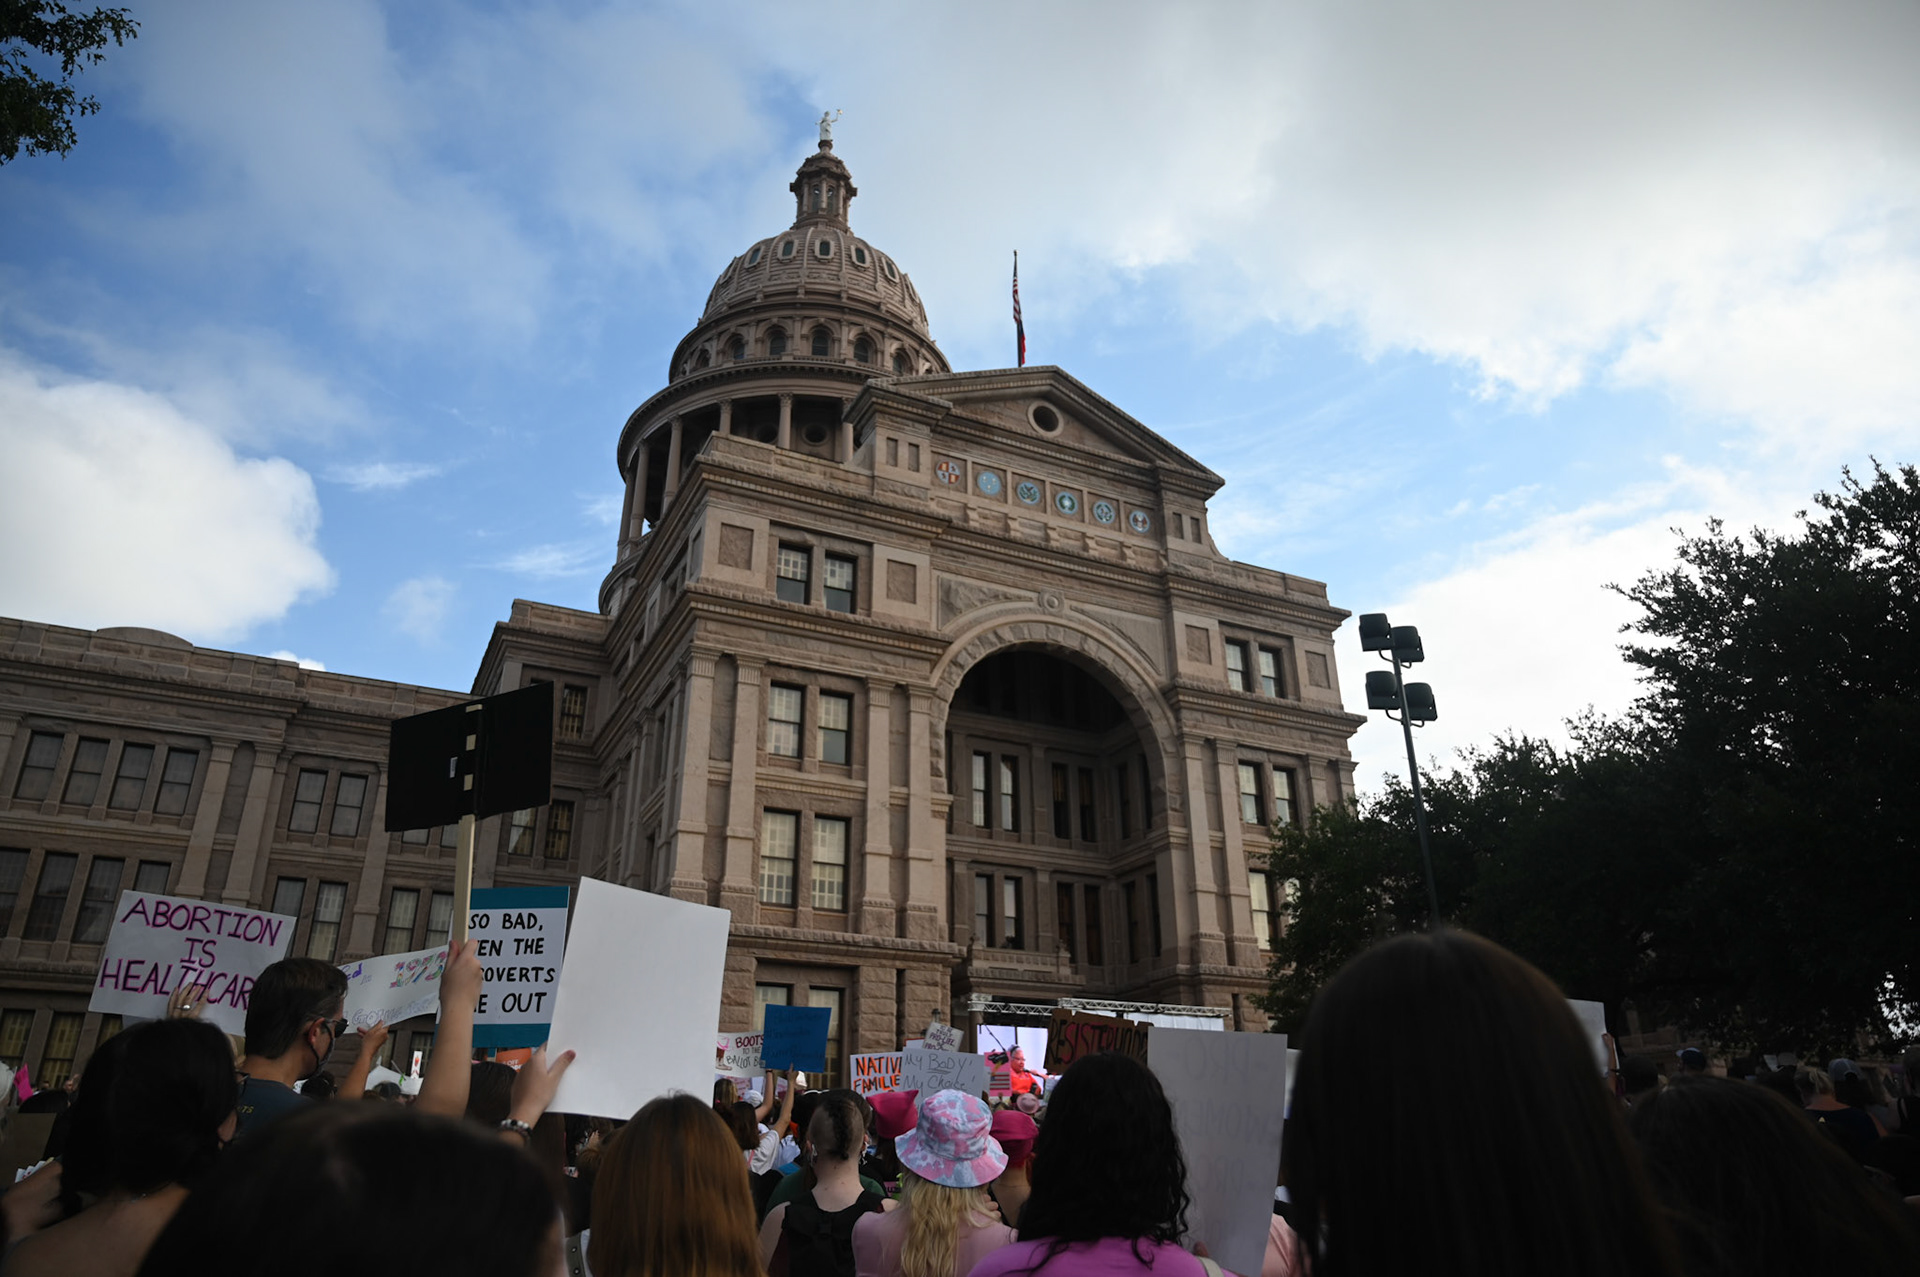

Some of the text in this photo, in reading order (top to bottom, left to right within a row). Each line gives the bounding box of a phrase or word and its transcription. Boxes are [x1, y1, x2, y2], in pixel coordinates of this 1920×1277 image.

[120, 898, 283, 947] ABORTION
[468, 912, 543, 931] SO BAD,
[180, 937, 217, 968] IS
[477, 937, 545, 956] EN THE
[99, 958, 255, 1010] HEALTHCAR
[501, 992, 547, 1013] OUT
[726, 1055, 751, 1069] BALLOT
